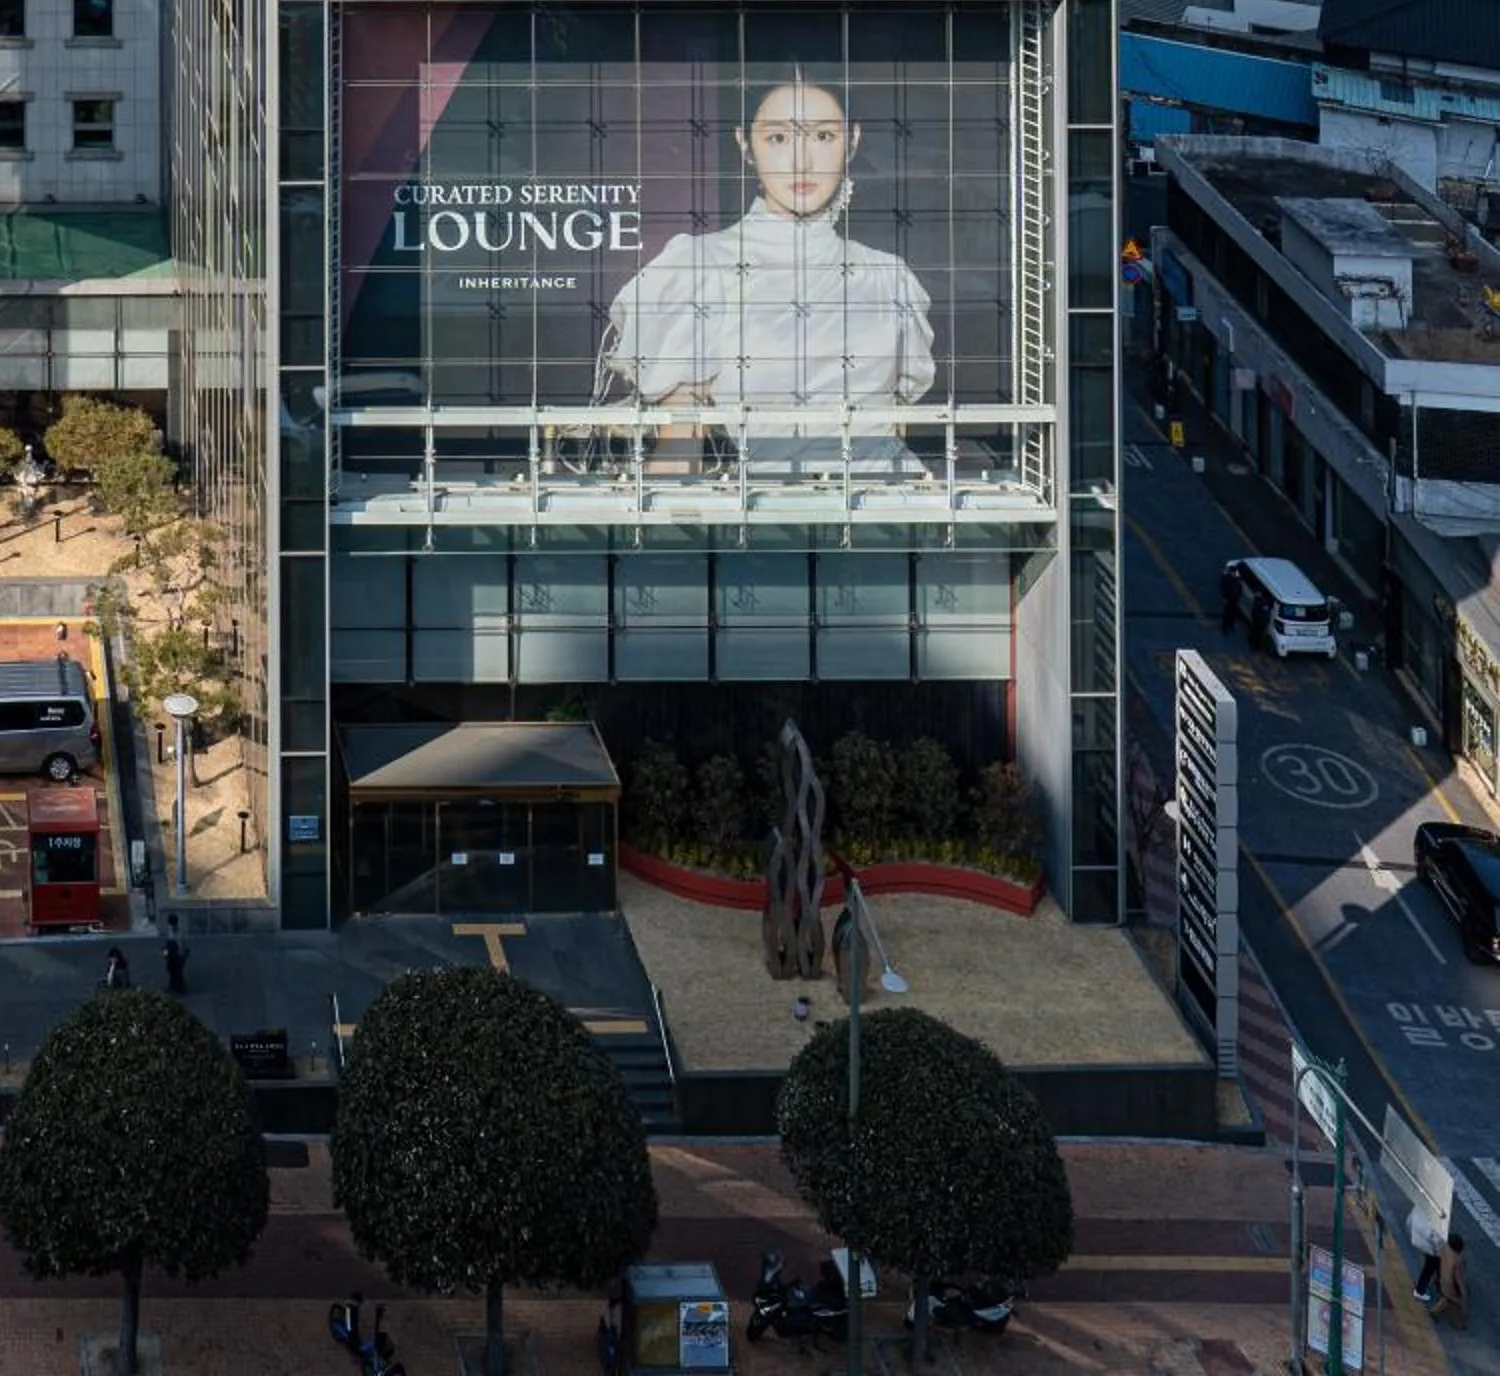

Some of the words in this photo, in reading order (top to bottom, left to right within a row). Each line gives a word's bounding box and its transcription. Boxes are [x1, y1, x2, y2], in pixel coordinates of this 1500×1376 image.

[393, 185, 513, 205] CURATED
[519, 185, 642, 204] SERENITY
[393, 210, 643, 252] LOUNGE
[458, 276, 577, 289] INHERITANCE
[1276, 755, 1359, 795] 30
[1386, 1002, 1500, 1051] 일방
